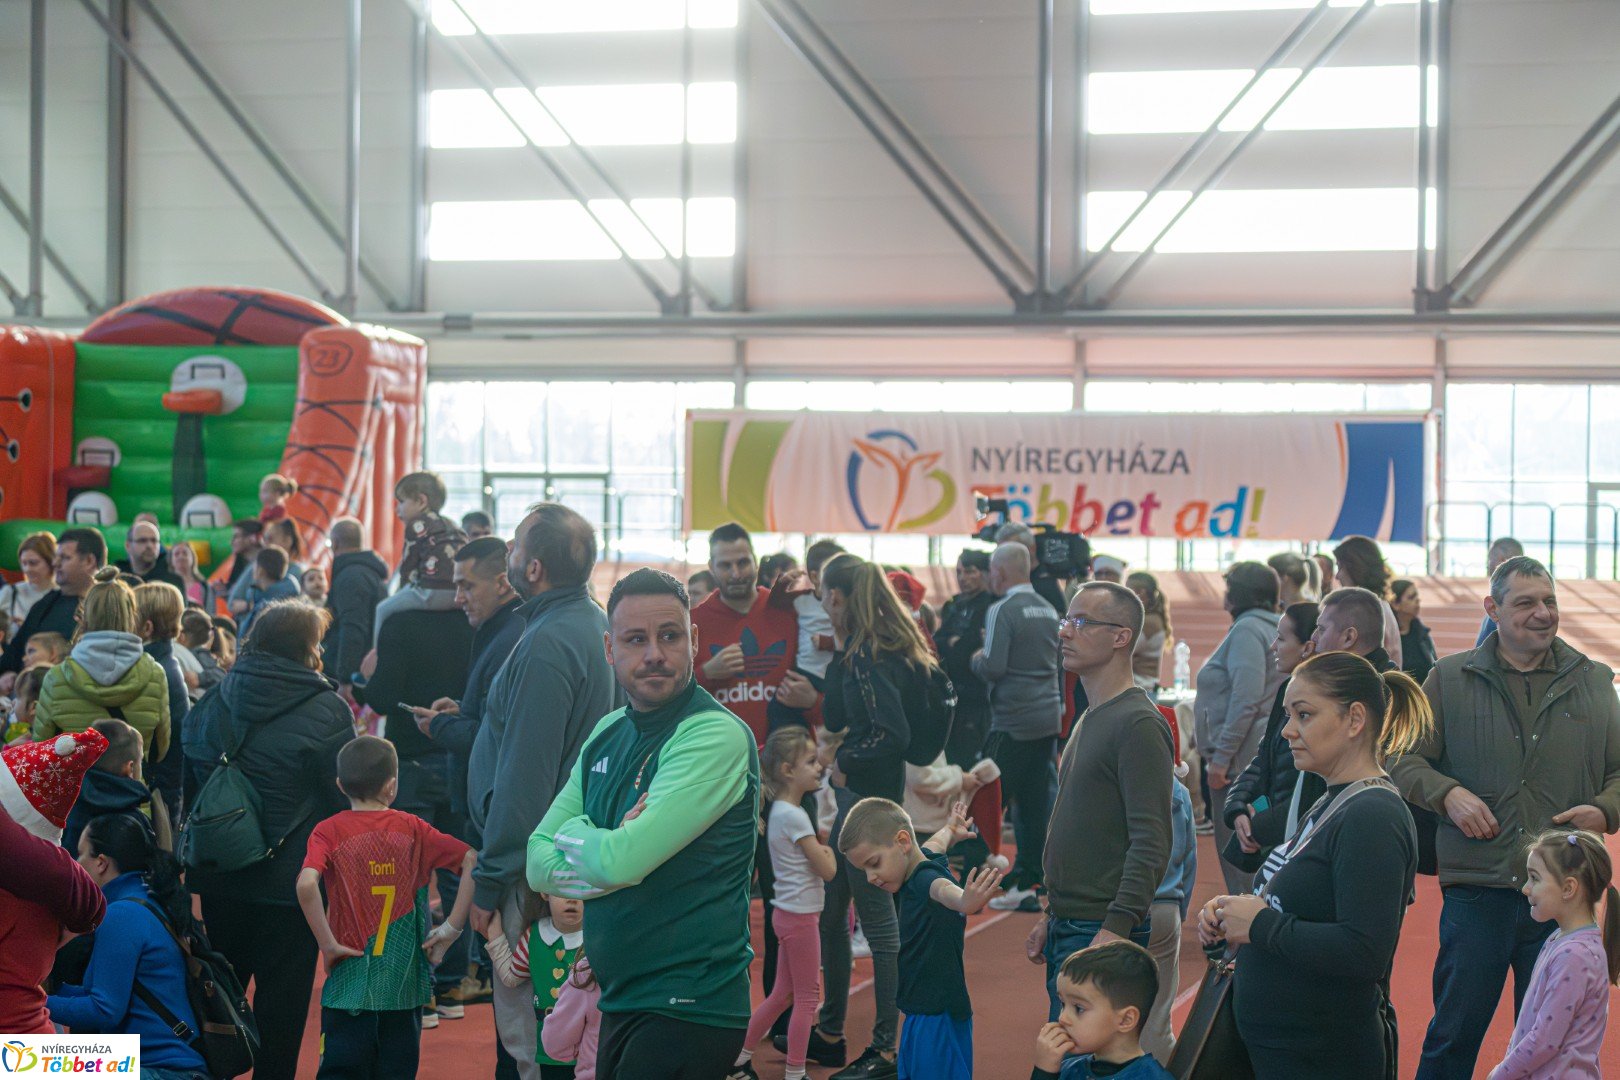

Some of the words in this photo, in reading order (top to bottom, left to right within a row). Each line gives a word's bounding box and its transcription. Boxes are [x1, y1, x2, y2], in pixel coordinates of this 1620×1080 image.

[314, 349, 341, 368] 23
[970, 443, 1190, 475] NYÍREGYHÁZA
[1174, 485, 1265, 538] ad!
[715, 681, 779, 703] adida
[368, 858, 396, 876] Tomi
[371, 885, 396, 957] 7
